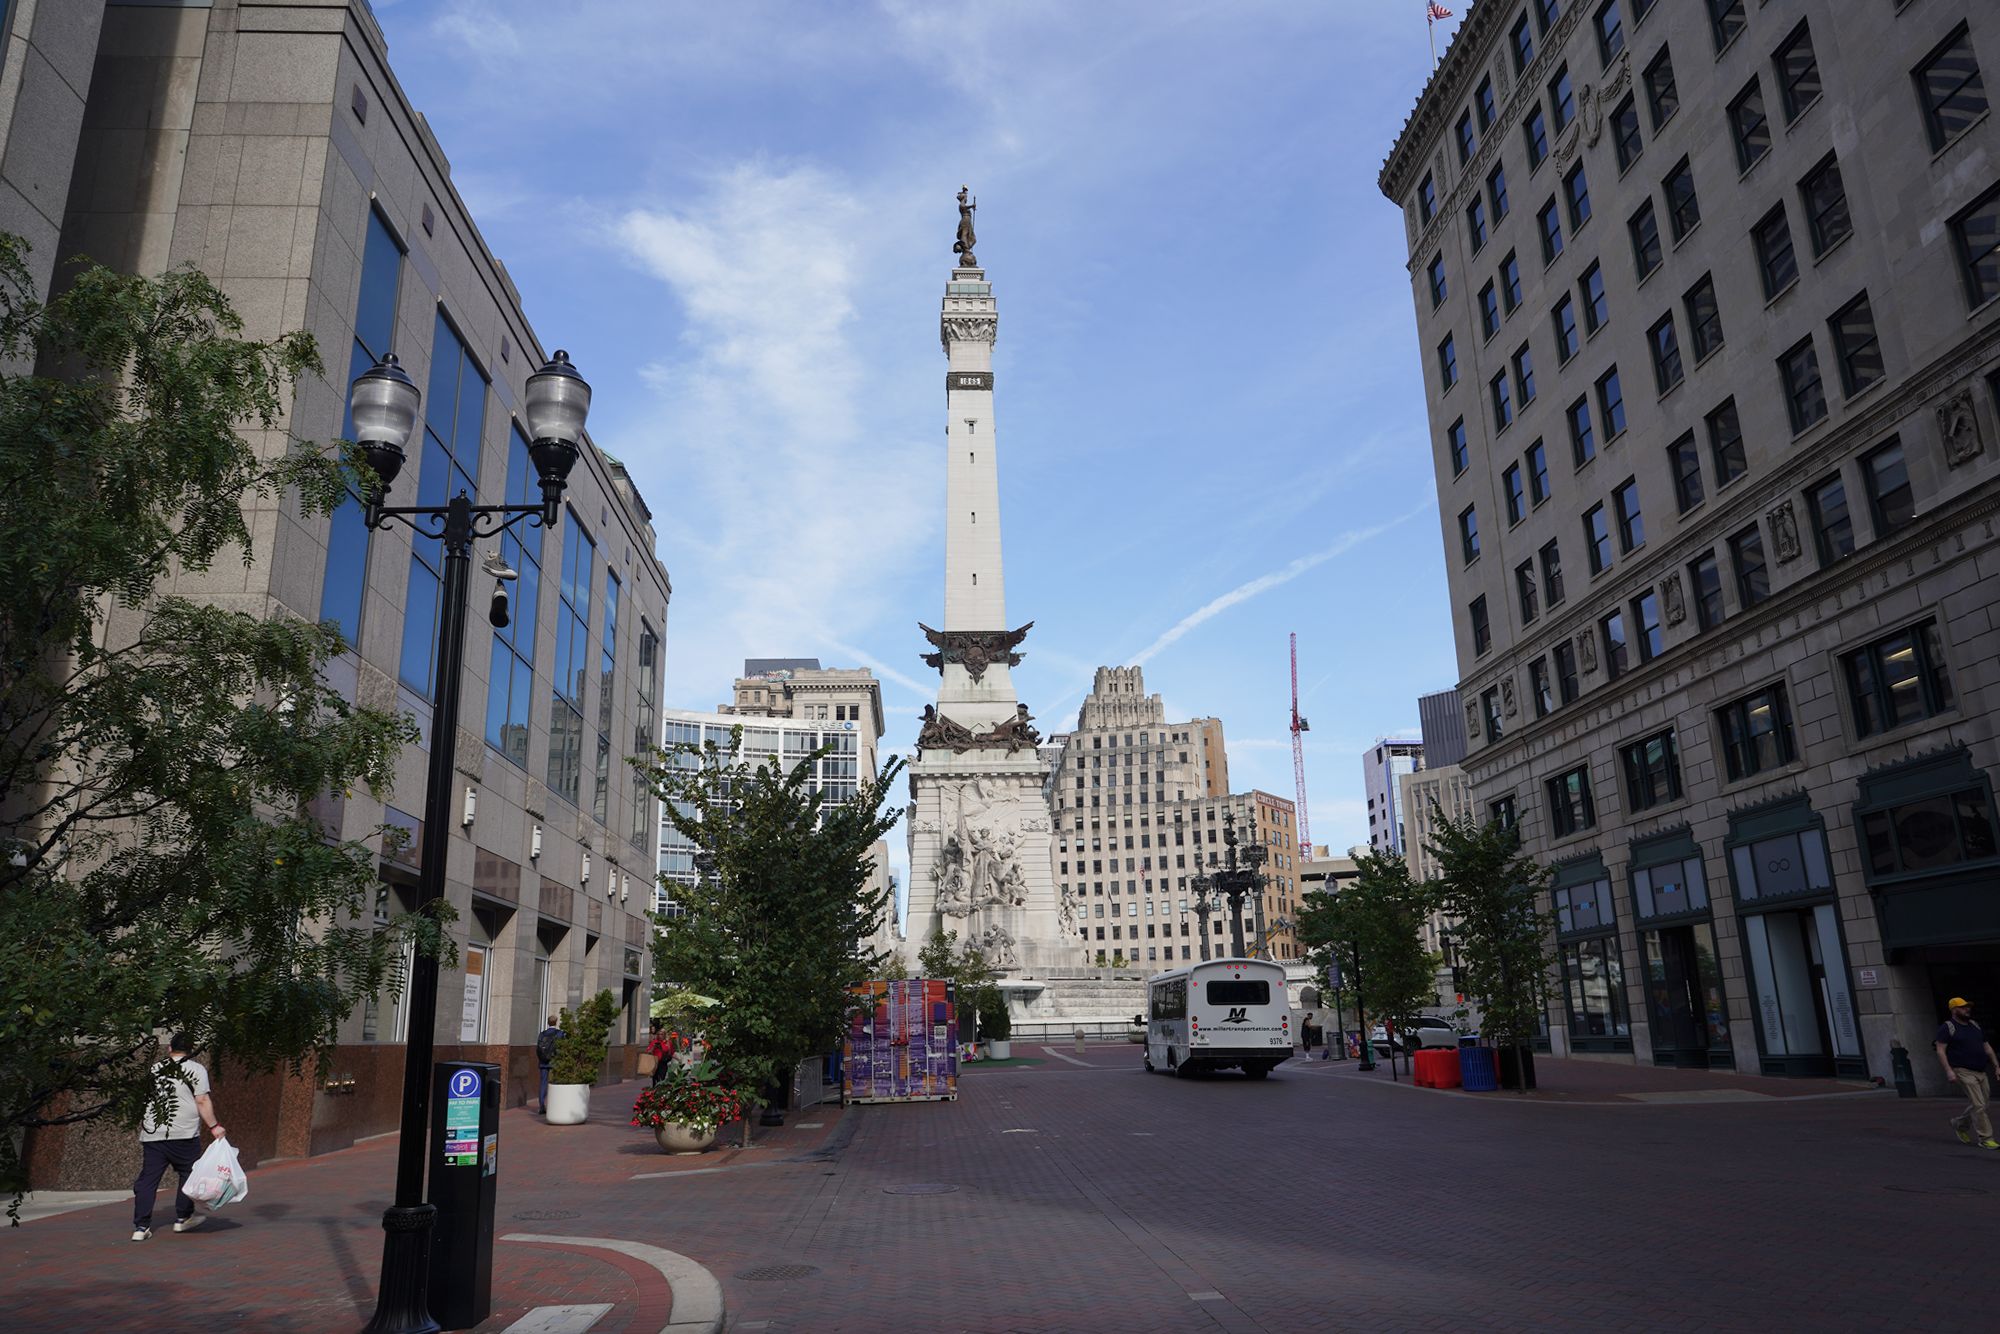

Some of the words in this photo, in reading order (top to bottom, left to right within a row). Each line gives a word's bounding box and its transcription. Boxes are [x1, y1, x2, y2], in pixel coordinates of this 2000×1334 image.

[809, 721, 843, 729] CHASE
[1229, 1008, 1247, 1018] M
[459, 1075, 473, 1092] P
